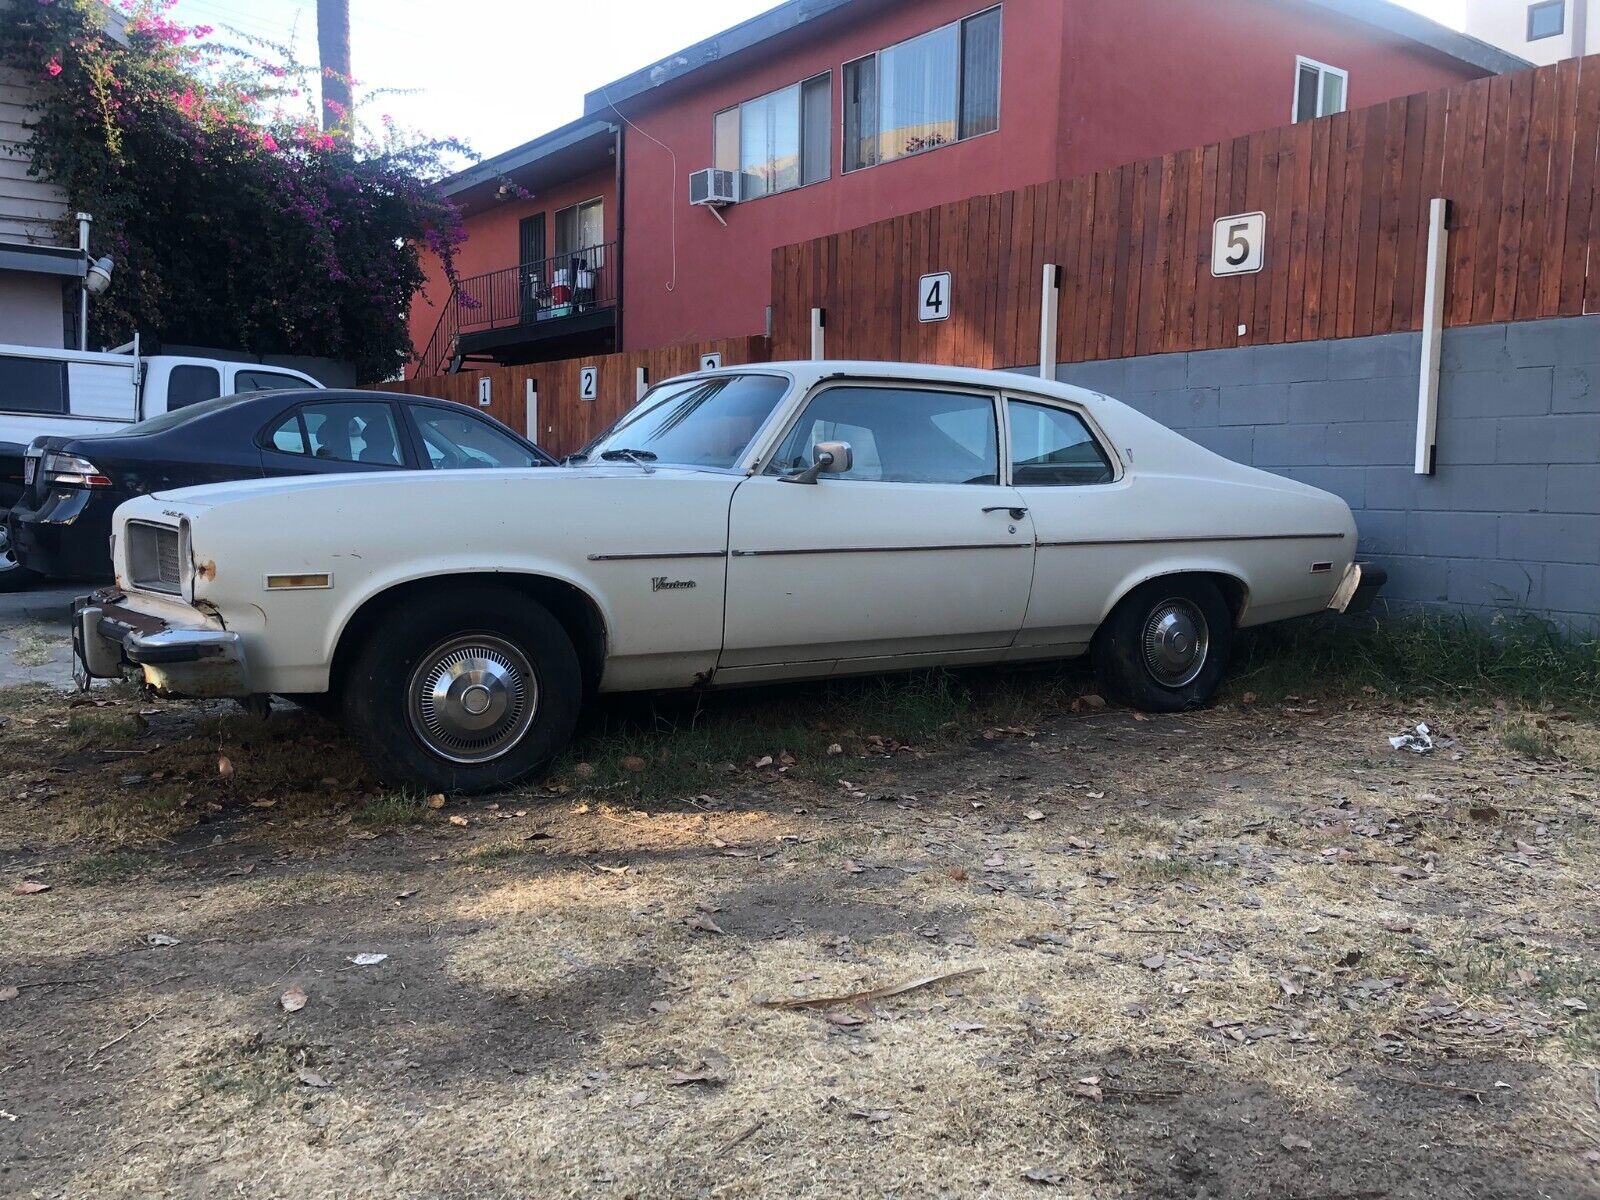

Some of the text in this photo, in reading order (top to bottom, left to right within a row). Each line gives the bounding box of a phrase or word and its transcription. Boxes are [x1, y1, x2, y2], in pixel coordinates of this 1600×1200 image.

[1226, 223, 1249, 265] 5
[926, 281, 942, 313] 4
[482, 382, 487, 402] 1
[584, 372, 592, 395] 2
